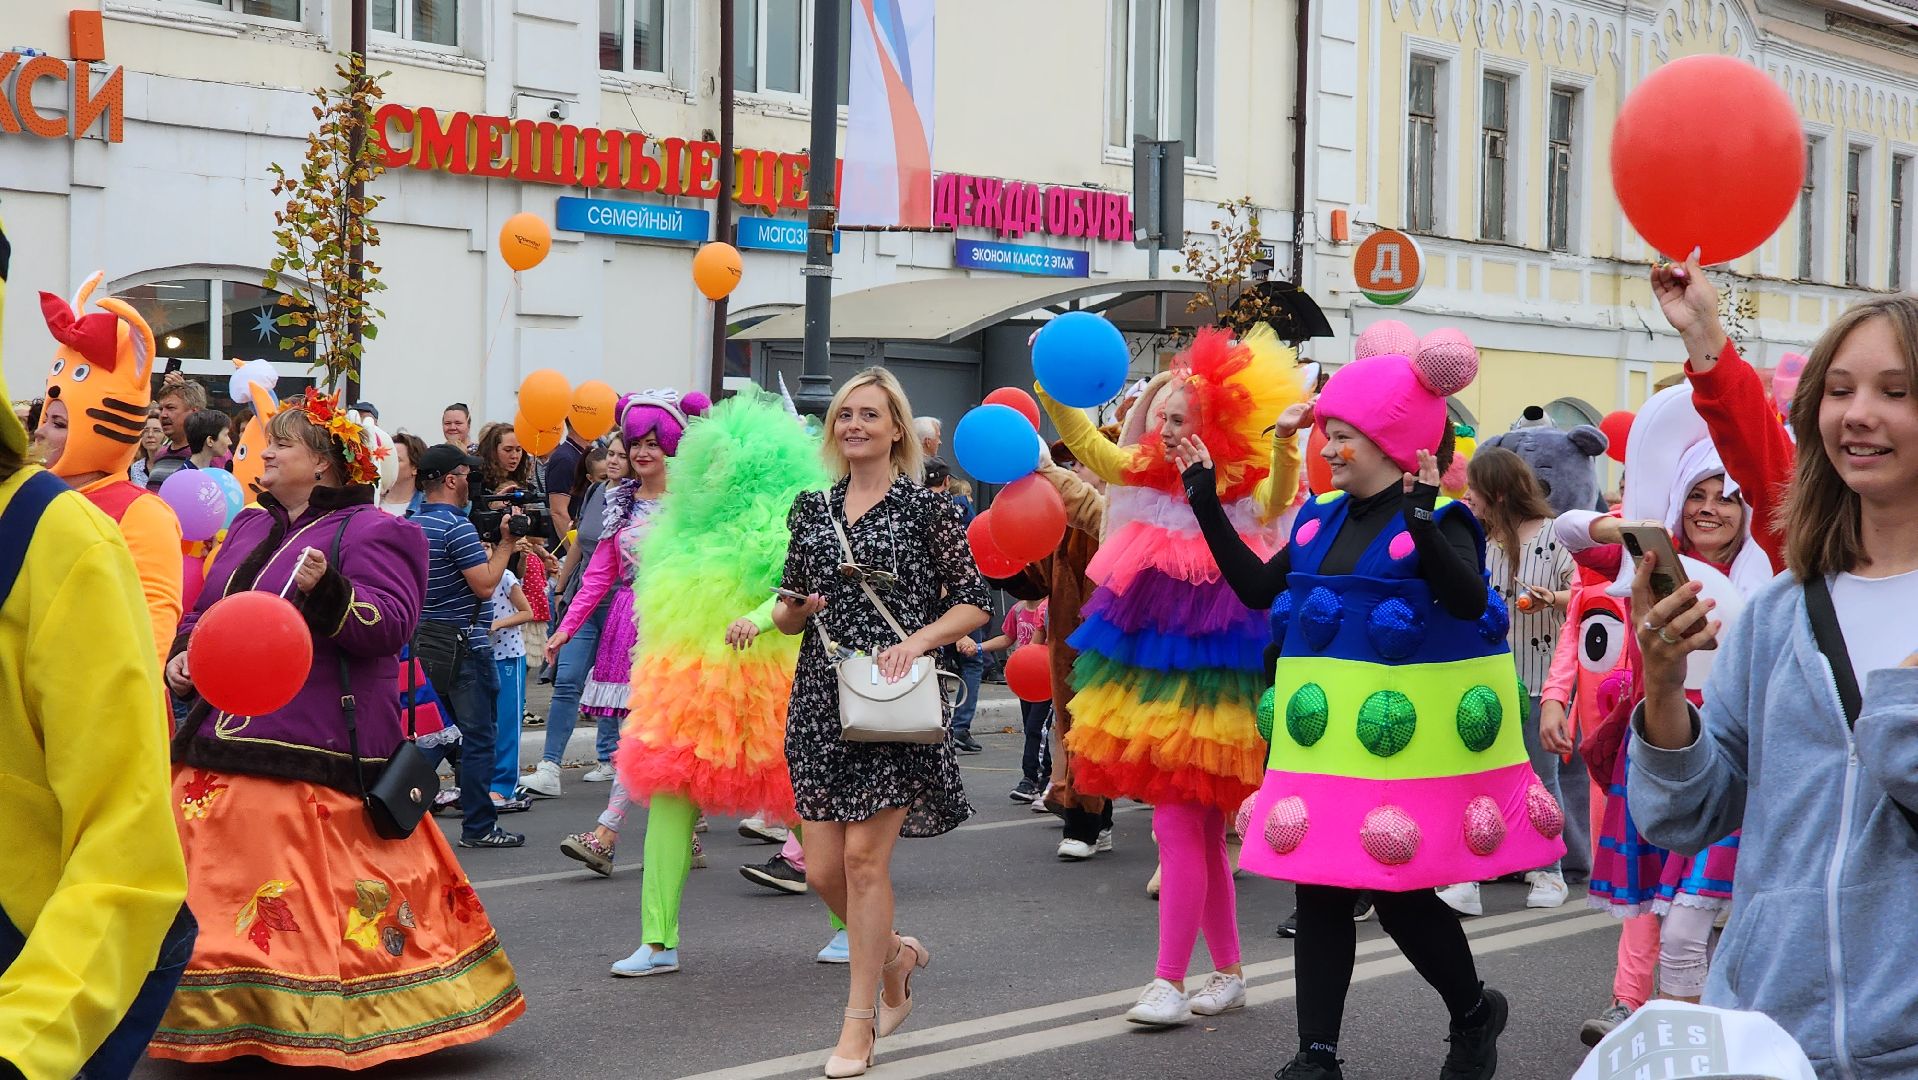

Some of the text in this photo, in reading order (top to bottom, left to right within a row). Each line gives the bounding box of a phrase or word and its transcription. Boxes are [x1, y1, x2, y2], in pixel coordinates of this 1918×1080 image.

[374, 103, 722, 200] СМЕШНЫЕ
[588, 206, 682, 232] семейный
[1044, 186, 1134, 242] ОБУВЬ
[972, 248, 1074, 269] ЭКОНОМ КЛАСС 2 ЭТАЖ
[1370, 243, 1402, 284] Д
[1608, 1020, 1707, 1073] TRÈS
